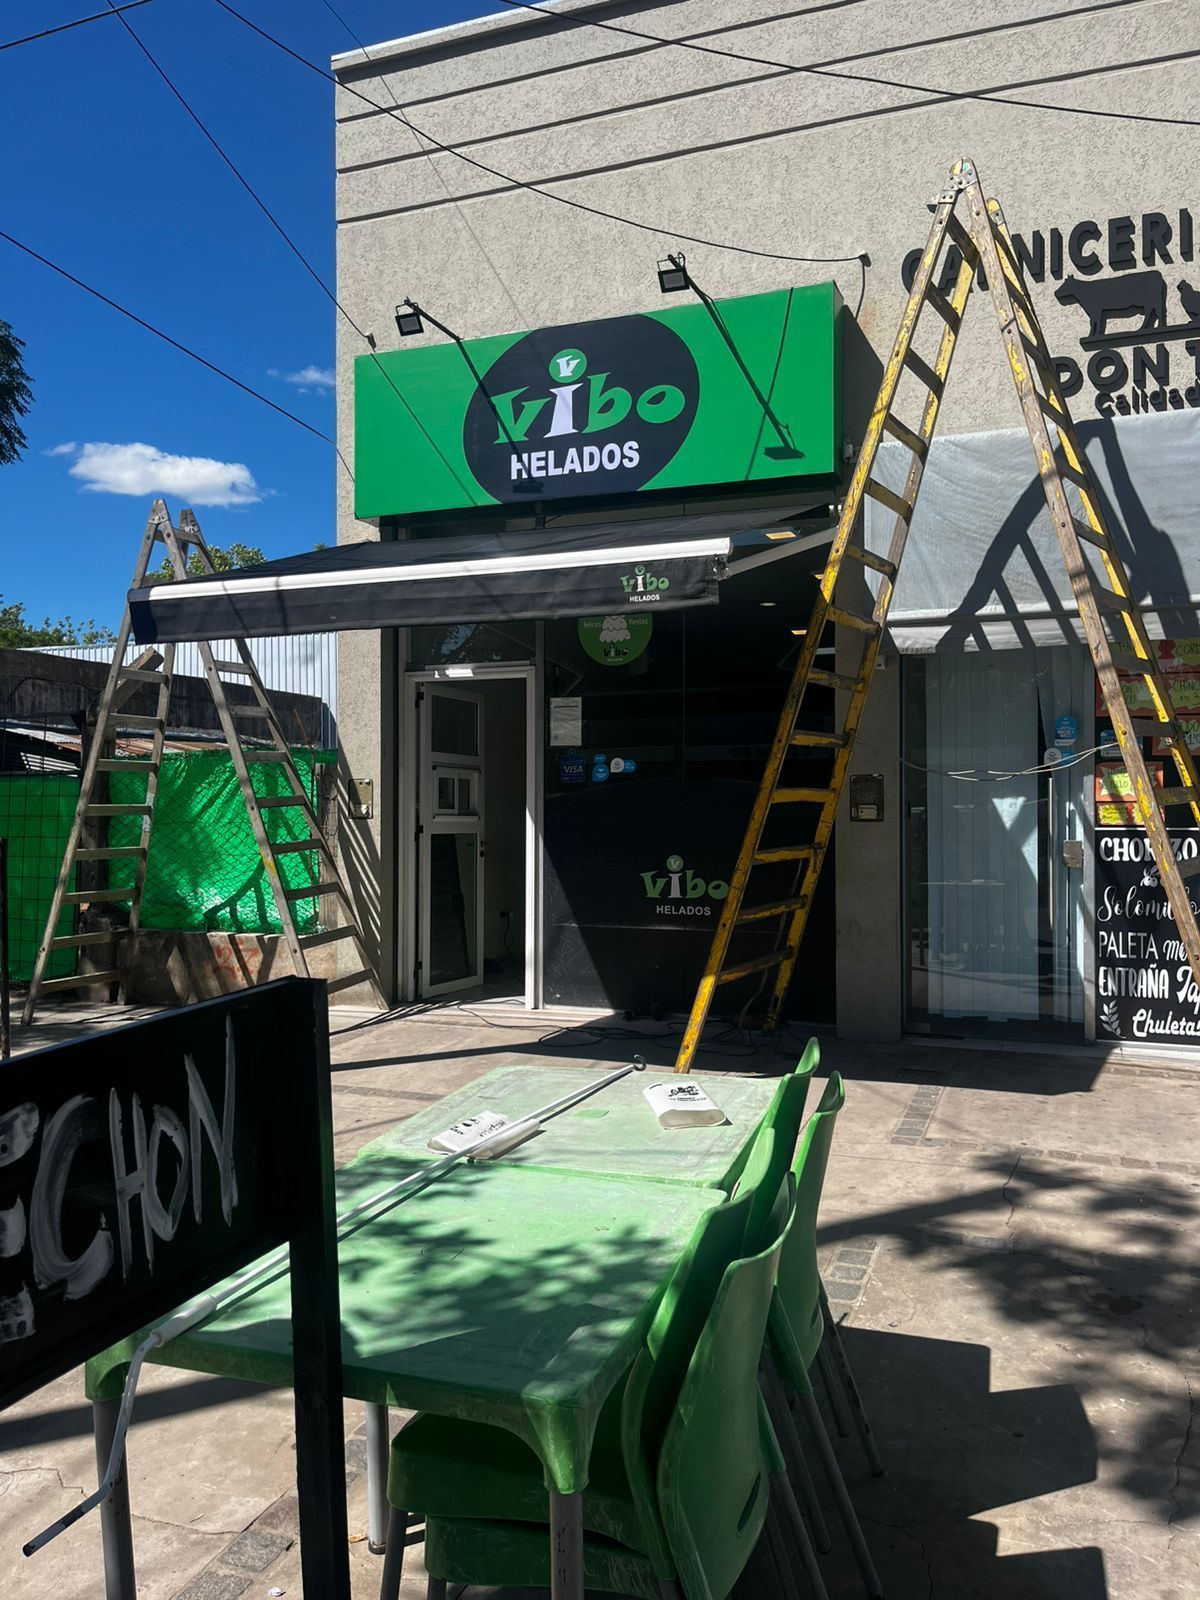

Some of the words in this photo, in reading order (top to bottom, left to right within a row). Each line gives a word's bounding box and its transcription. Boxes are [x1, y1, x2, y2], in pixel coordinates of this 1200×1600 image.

[901, 207, 1200, 297] CANICERI
[510, 440, 641, 480] HELADOS
[629, 594, 661, 603] HELADOS
[563, 765, 584, 774] VISA
[1099, 837, 1198, 862] CHORZO
[656, 905, 711, 916] HELADOS
[1097, 885, 1200, 922] Solomilo
[1098, 931, 1159, 960] PALETA
[1098, 963, 1170, 1000] ENTRAÑA
